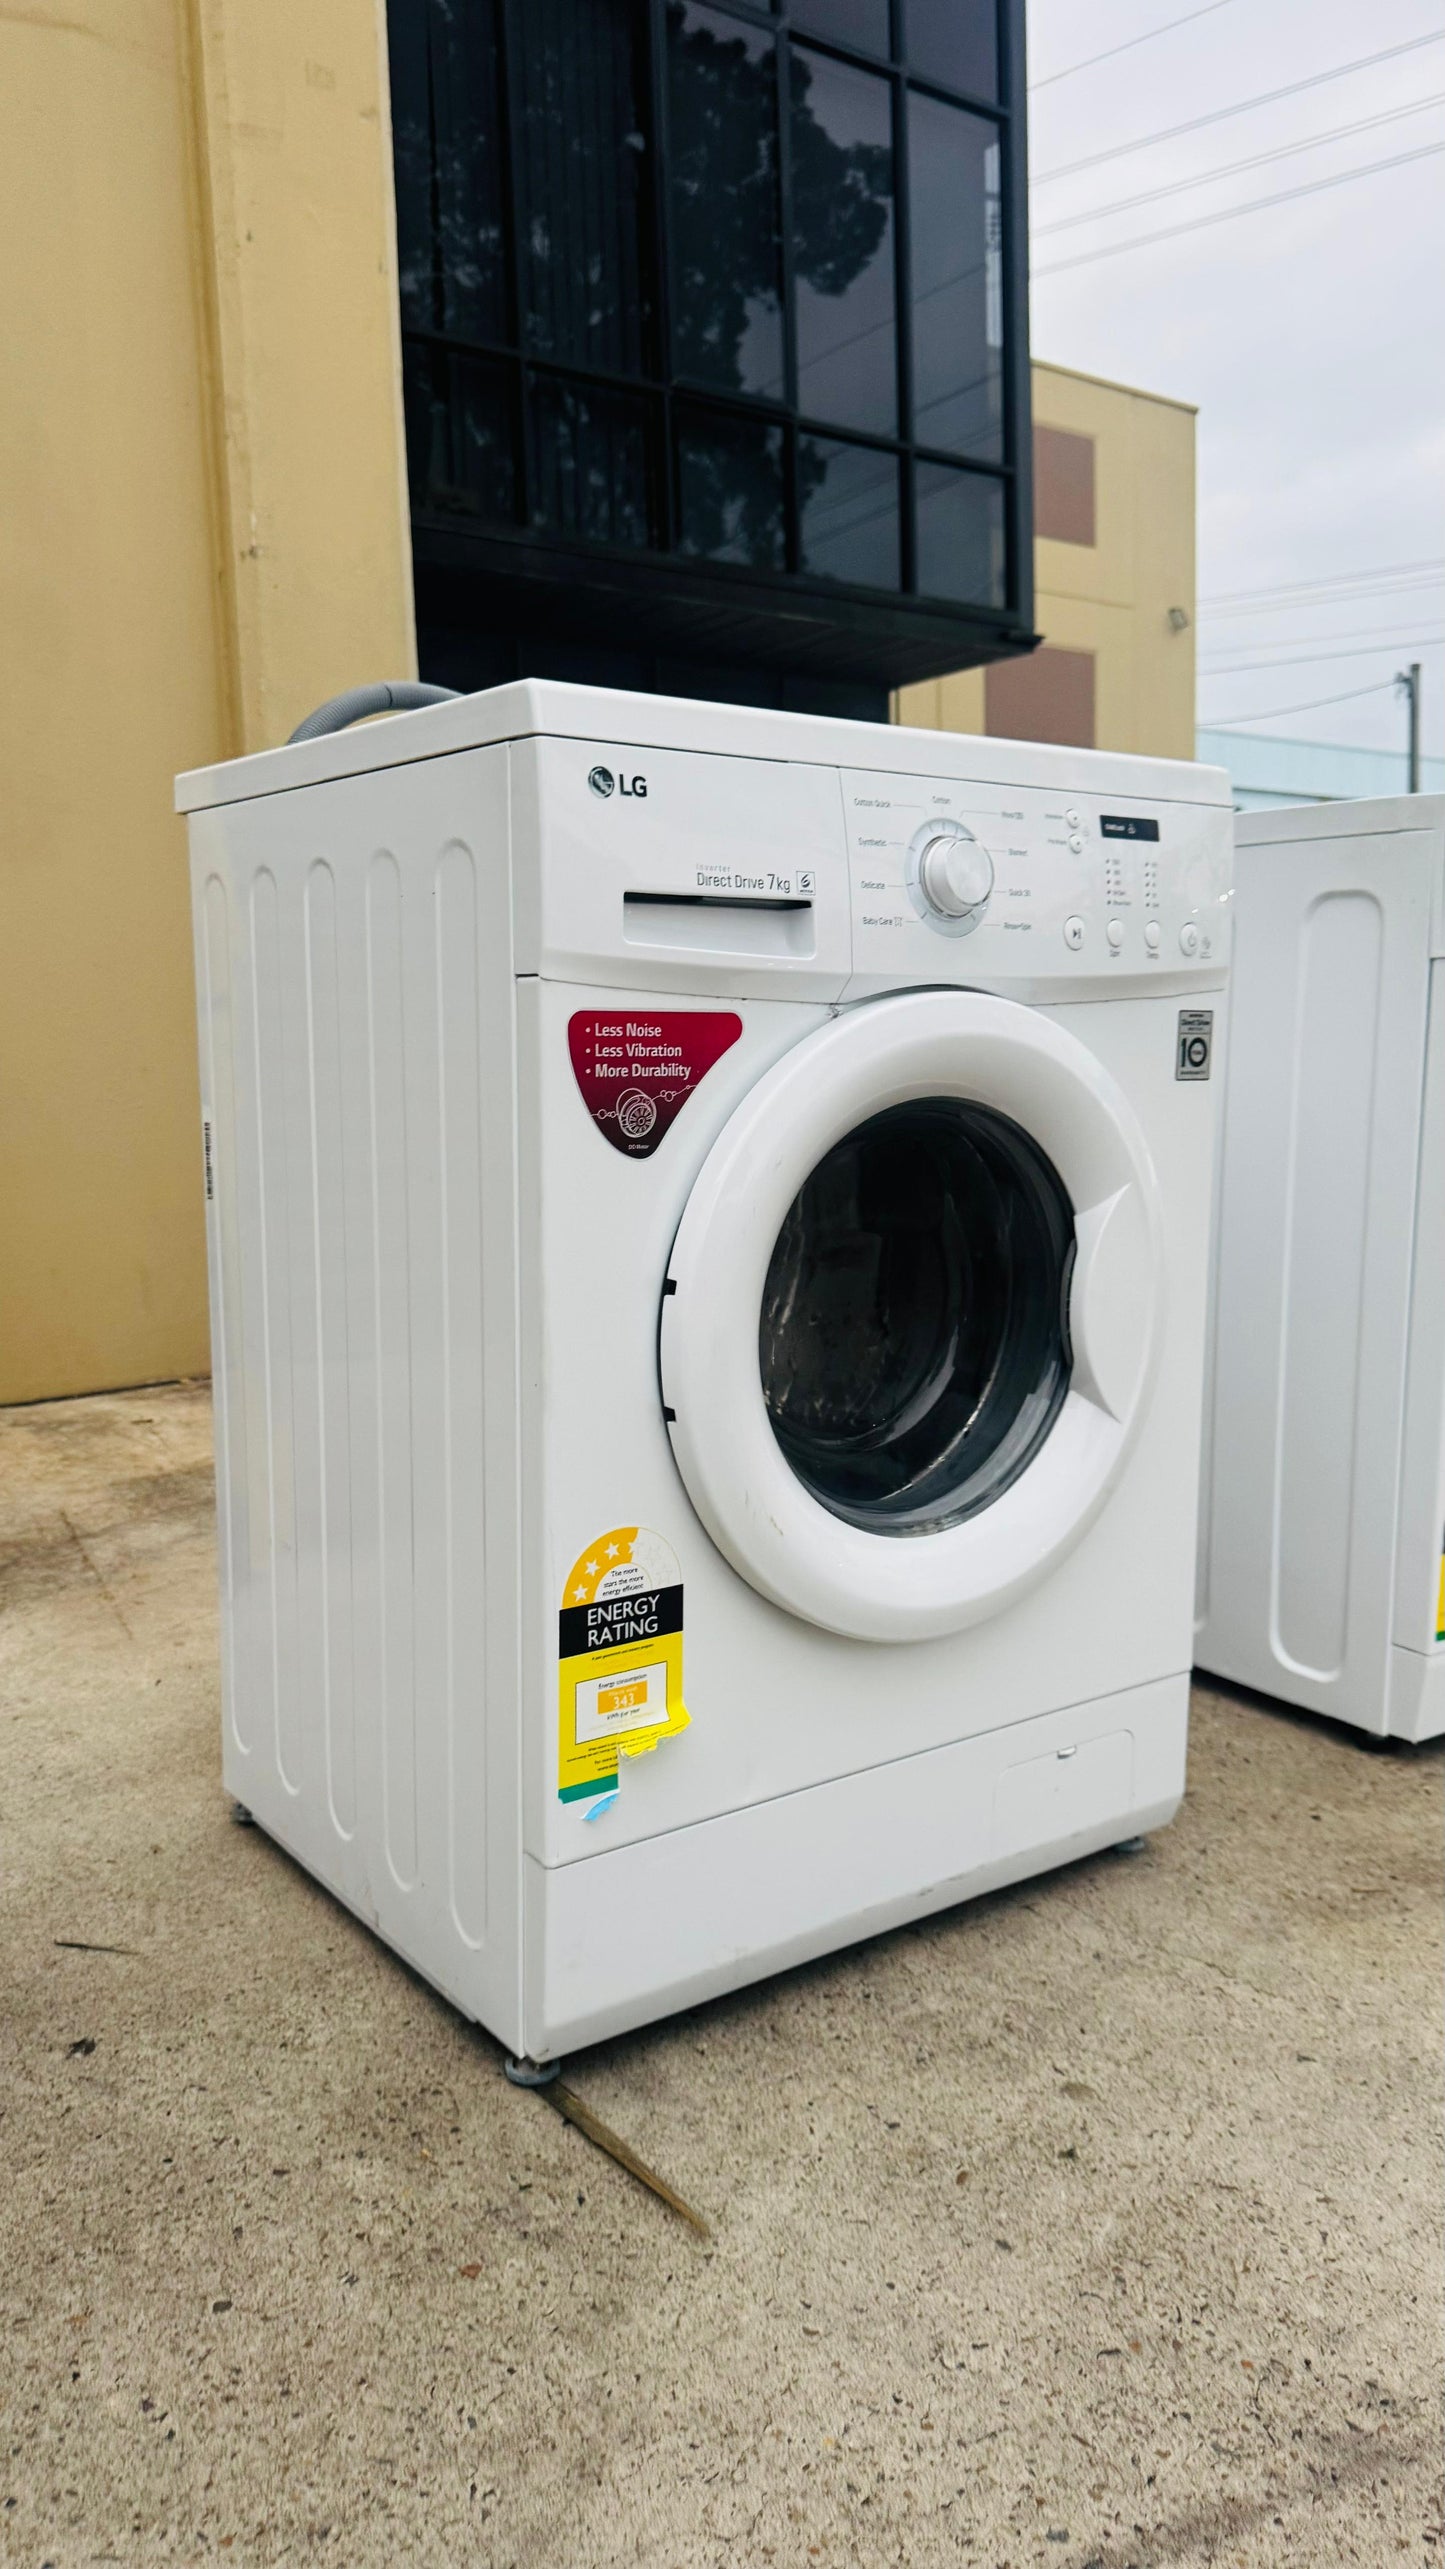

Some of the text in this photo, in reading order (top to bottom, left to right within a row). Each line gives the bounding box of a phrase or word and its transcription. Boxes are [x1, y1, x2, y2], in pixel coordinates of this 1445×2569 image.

[619, 773, 648, 798] LG
[696, 872, 732, 888] Direct
[735, 875, 764, 890] Drive
[595, 1023, 662, 1037] Less Noise
[595, 1043, 682, 1057] Less Vibration
[1180, 1036, 1208, 1068] 10
[595, 1063, 692, 1080] More Durability
[623, 1567, 638, 1575] more
[628, 1575, 644, 1583] more
[602, 1583, 644, 1597] energy efficient
[587, 1594, 660, 1627] ENERGY
[587, 1616, 658, 1648] RATING
[598, 1681, 615, 1690] Energy
